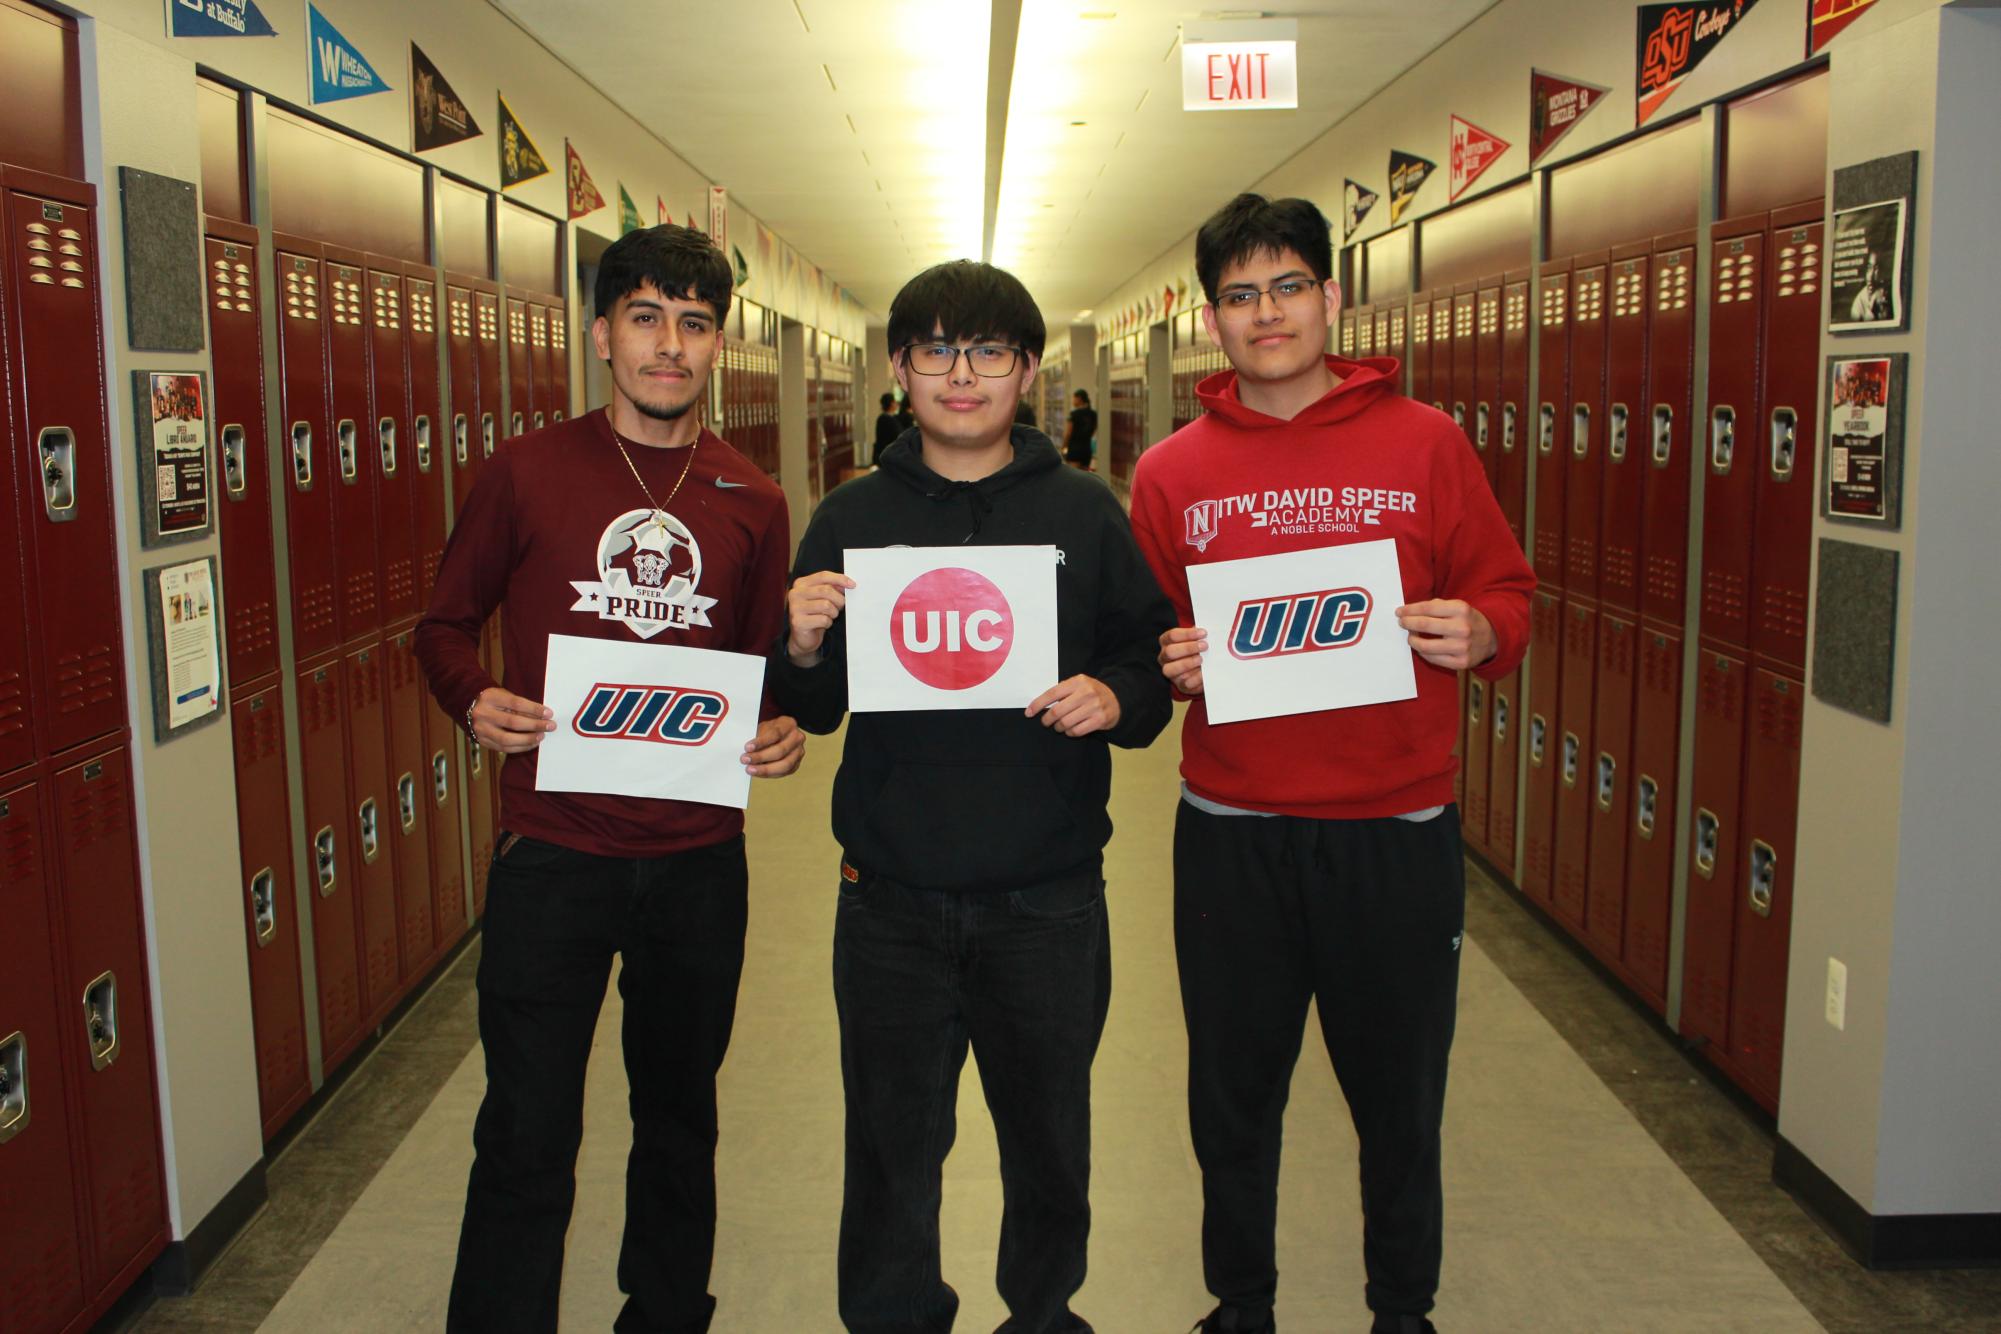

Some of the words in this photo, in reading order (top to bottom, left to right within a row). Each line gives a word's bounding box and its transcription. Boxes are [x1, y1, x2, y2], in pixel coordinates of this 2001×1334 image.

[206, 2, 216, 19] at
[216, 4, 245, 33] Buffalo
[1695, 6, 1731, 41] Cowboys
[317, 36, 341, 87] W
[341, 48, 372, 81] WHEATON
[1642, 7, 1695, 90] OSU
[1207, 53, 1270, 100] EXIT
[1549, 87, 1577, 111] MONTANA
[1218, 493, 1257, 518] ITW
[1264, 487, 1333, 510] DAVID
[1341, 487, 1416, 513] SPEER
[1269, 507, 1363, 526] ACADEMY
[1193, 505, 1209, 536] N
[1271, 526, 1278, 536] A
[1281, 524, 1315, 535] NOBLE
[1318, 523, 1360, 534] SCHOOL
[636, 588, 661, 598] SPEER
[606, 596, 685, 625] PRIDE
[1230, 588, 1369, 657] UIC
[902, 610, 1004, 653] UIC
[575, 685, 726, 744] UIC
